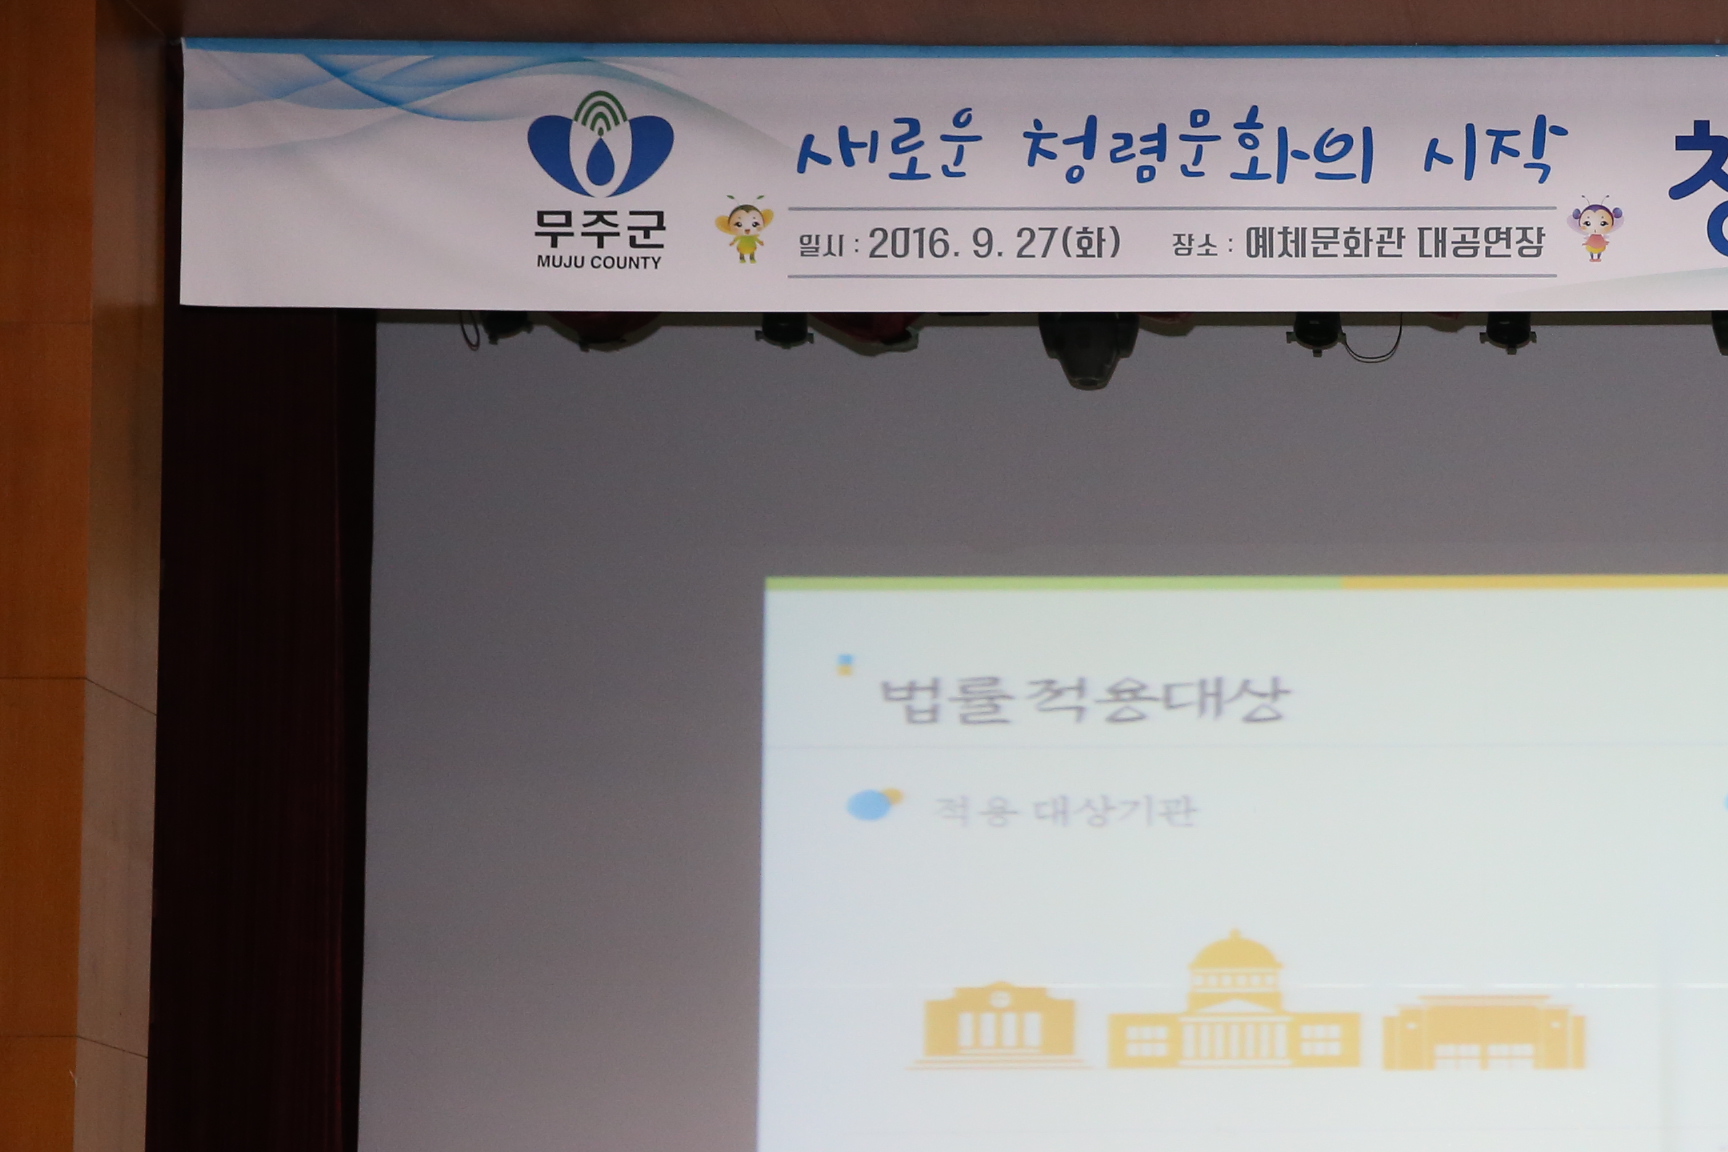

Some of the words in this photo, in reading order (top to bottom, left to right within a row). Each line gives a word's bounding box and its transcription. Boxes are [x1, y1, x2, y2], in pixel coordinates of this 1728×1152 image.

[797, 108, 982, 180] 새로운
[1023, 105, 1373, 184] 청렴문화의
[1424, 114, 1568, 184] 시작
[535, 211, 666, 248] 무주군
[800, 234, 844, 257] 일시
[868, 227, 960, 258] 2016.
[1017, 226, 1120, 258] 27(화)
[1173, 234, 1217, 256] 장소
[1247, 226, 1405, 258] 예체문화관
[1418, 226, 1545, 258] 대공연장
[538, 254, 584, 269] MUJU
[591, 254, 661, 269] COUNTY
[1033, 793, 1200, 829] 대상기관
